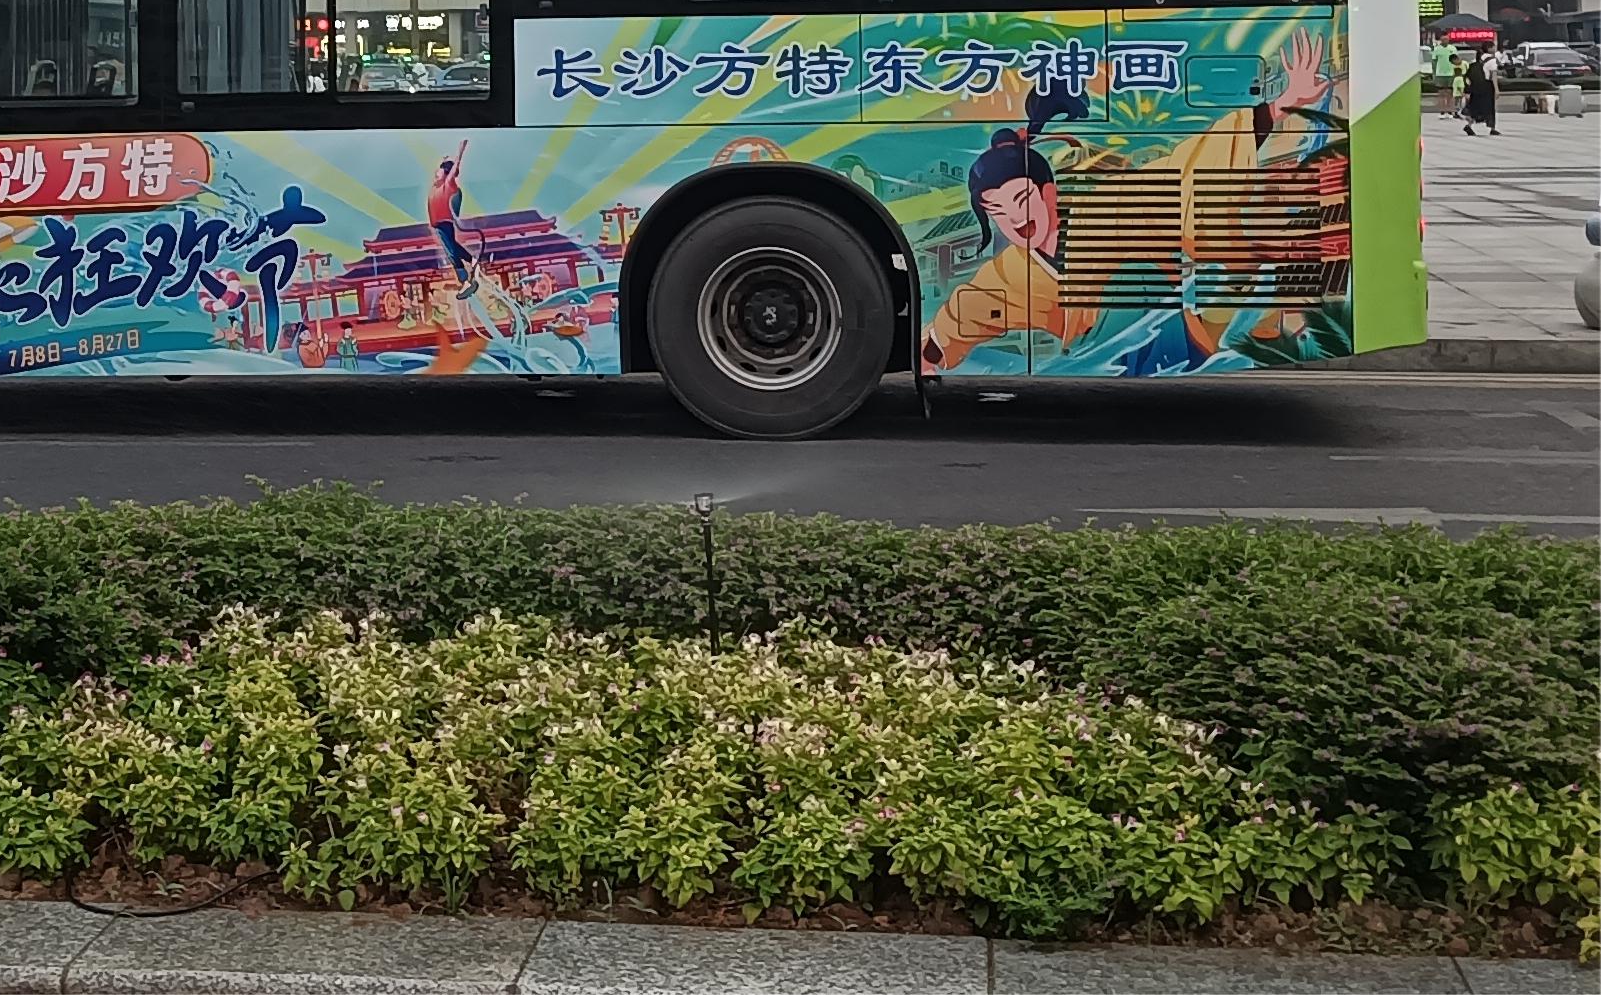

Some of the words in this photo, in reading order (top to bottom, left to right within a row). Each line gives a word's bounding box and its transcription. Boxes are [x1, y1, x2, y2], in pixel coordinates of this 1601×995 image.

[535, 38, 1190, 99] 长沙方特东方神画
